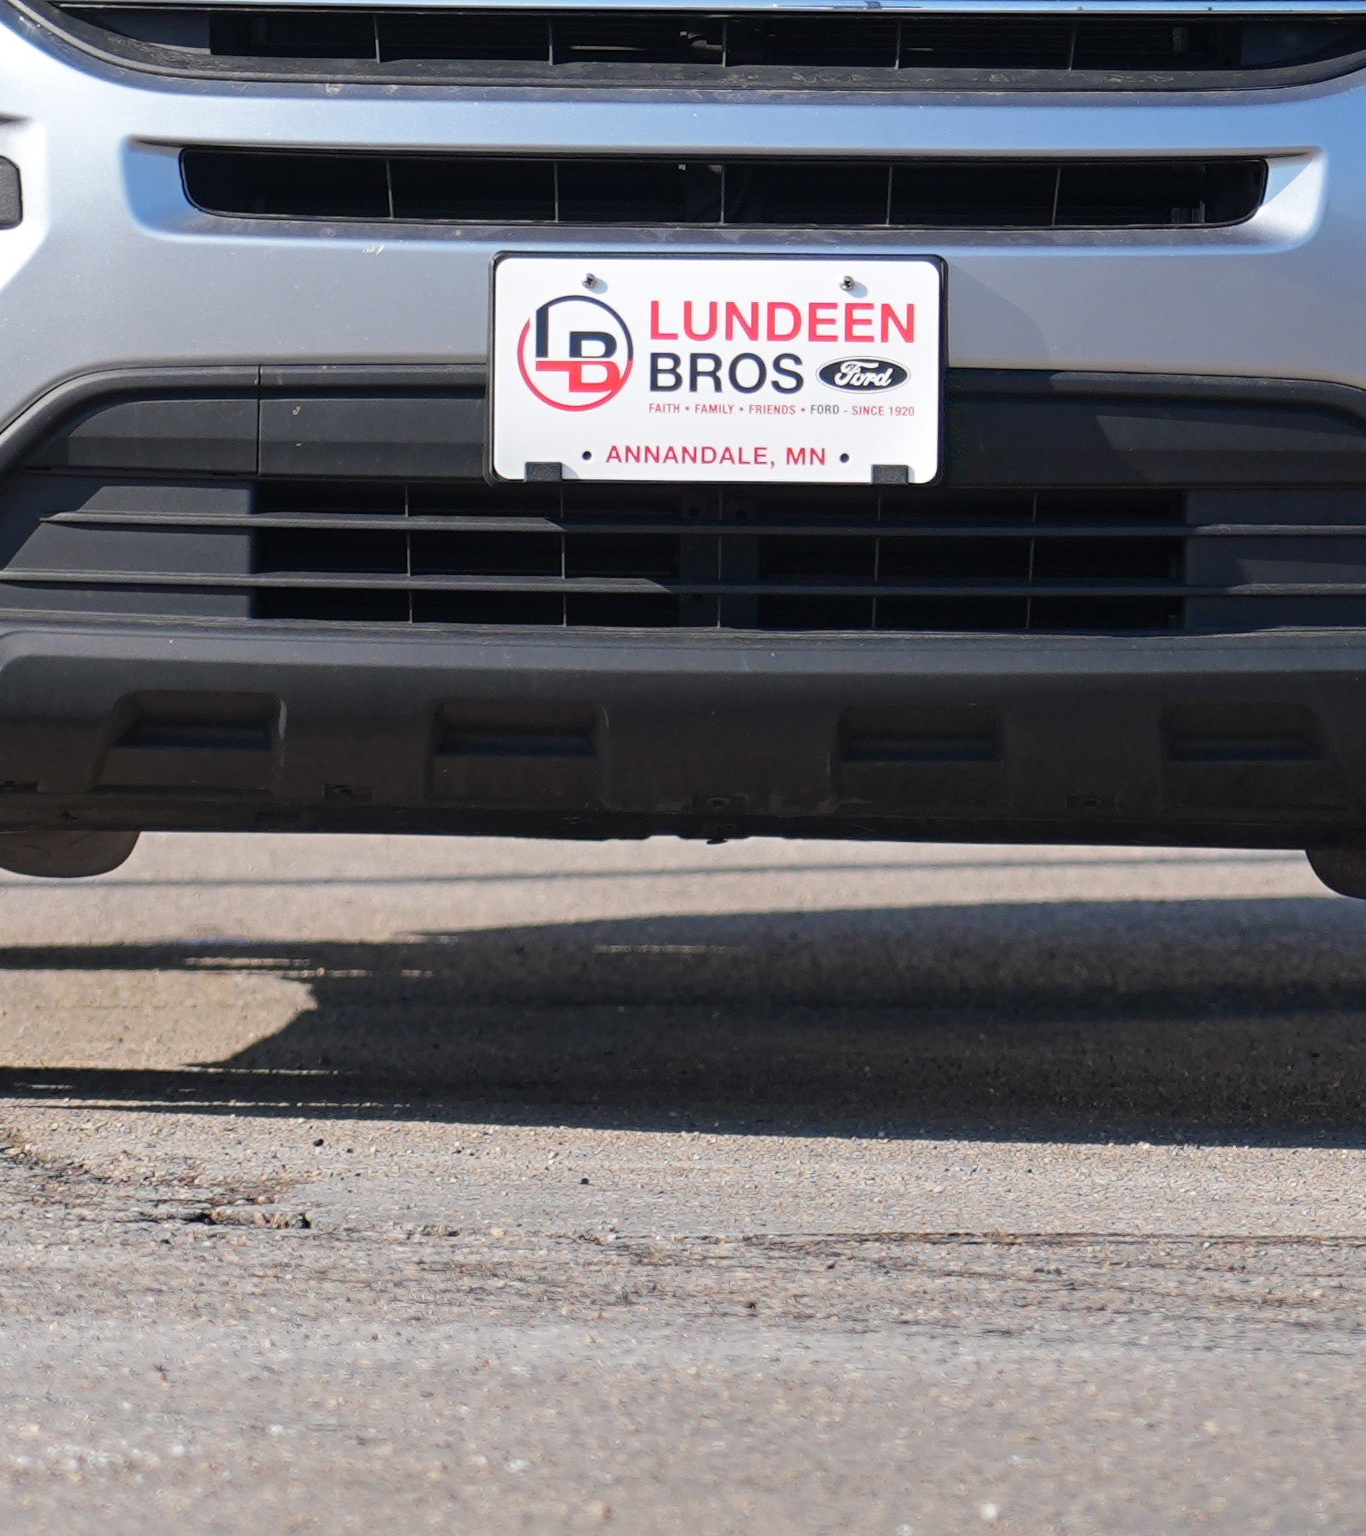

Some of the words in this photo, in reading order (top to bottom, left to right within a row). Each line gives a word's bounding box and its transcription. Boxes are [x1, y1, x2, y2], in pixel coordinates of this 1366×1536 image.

[651, 301, 915, 343] LUNDEEN
[649, 352, 804, 394] BROS
[834, 361, 893, 386] Ford
[648, 403, 680, 414] FAITH
[695, 404, 734, 414] FAMILY
[749, 405, 796, 415] FRIENDS
[810, 405, 840, 414] FORD
[852, 406, 884, 416] SINCE
[889, 406, 915, 416] 1920
[606, 445, 775, 468] ANNANDALE,
[786, 448, 826, 465] MN
